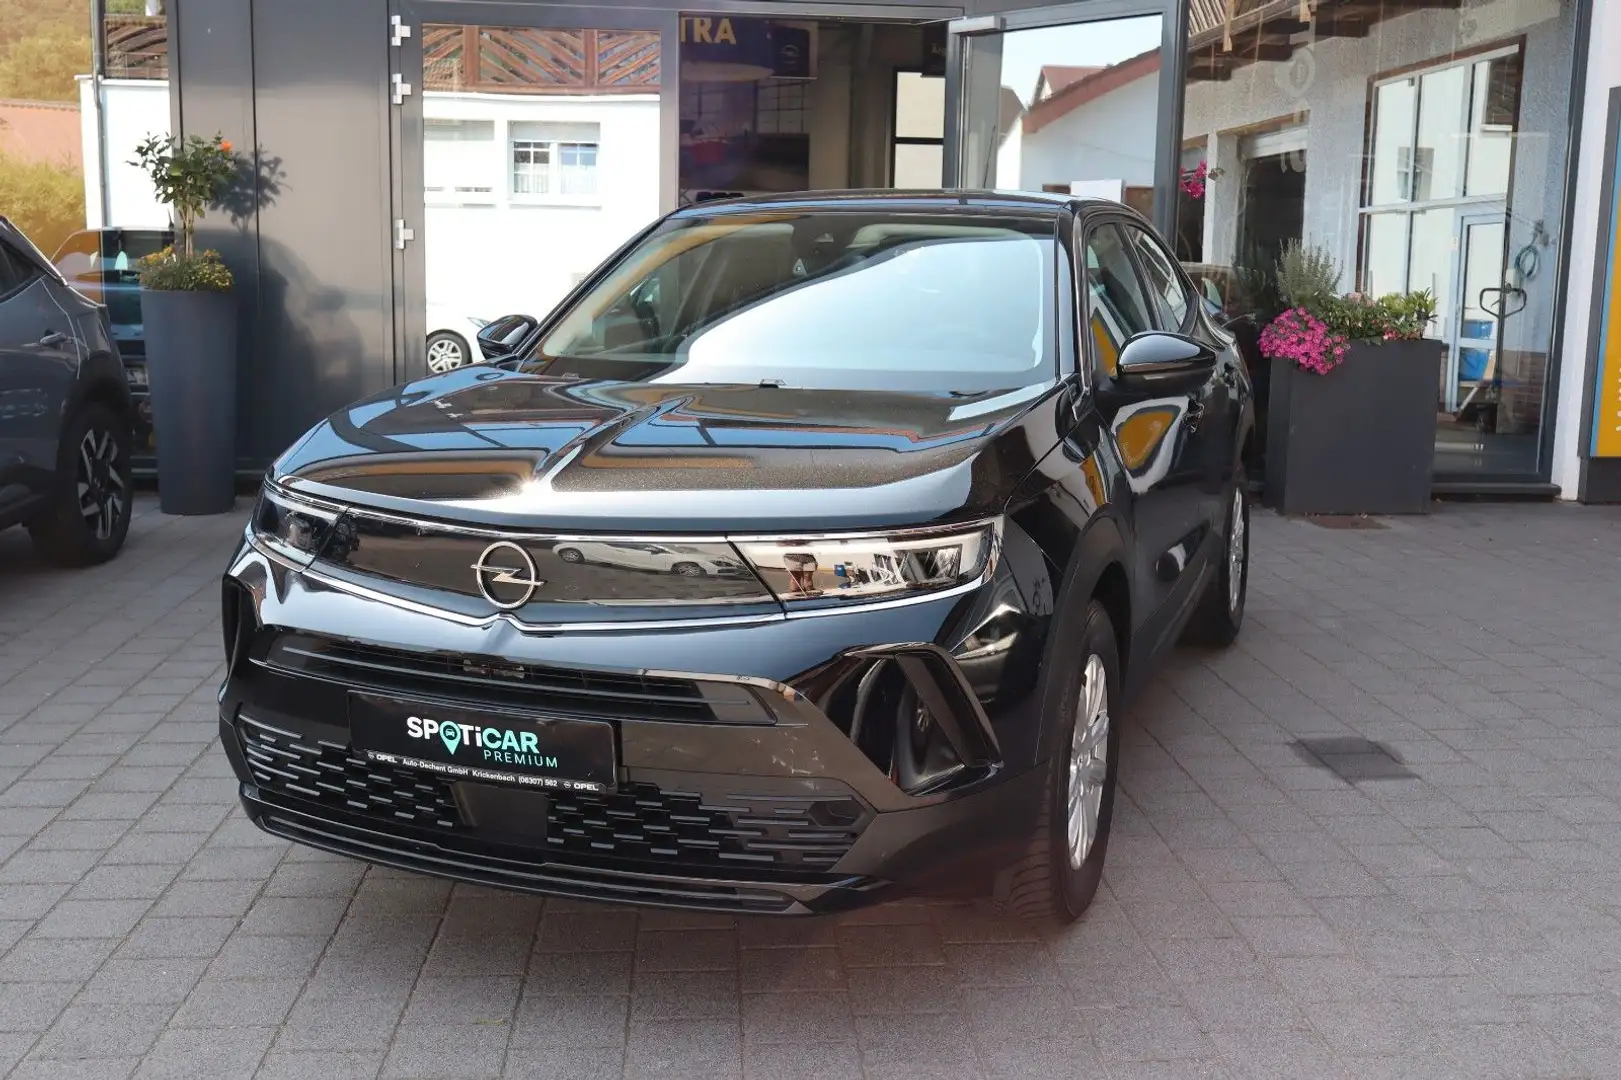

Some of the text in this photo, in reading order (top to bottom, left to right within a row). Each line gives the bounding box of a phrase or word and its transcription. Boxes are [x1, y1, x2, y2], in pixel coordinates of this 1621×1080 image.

[376, 754, 398, 763] OPEL
[447, 765, 468, 775] GmbH
[472, 770, 515, 782] Krickenbach
[574, 783, 599, 791] OPEL
[484, 750, 558, 768] PREMIUM
